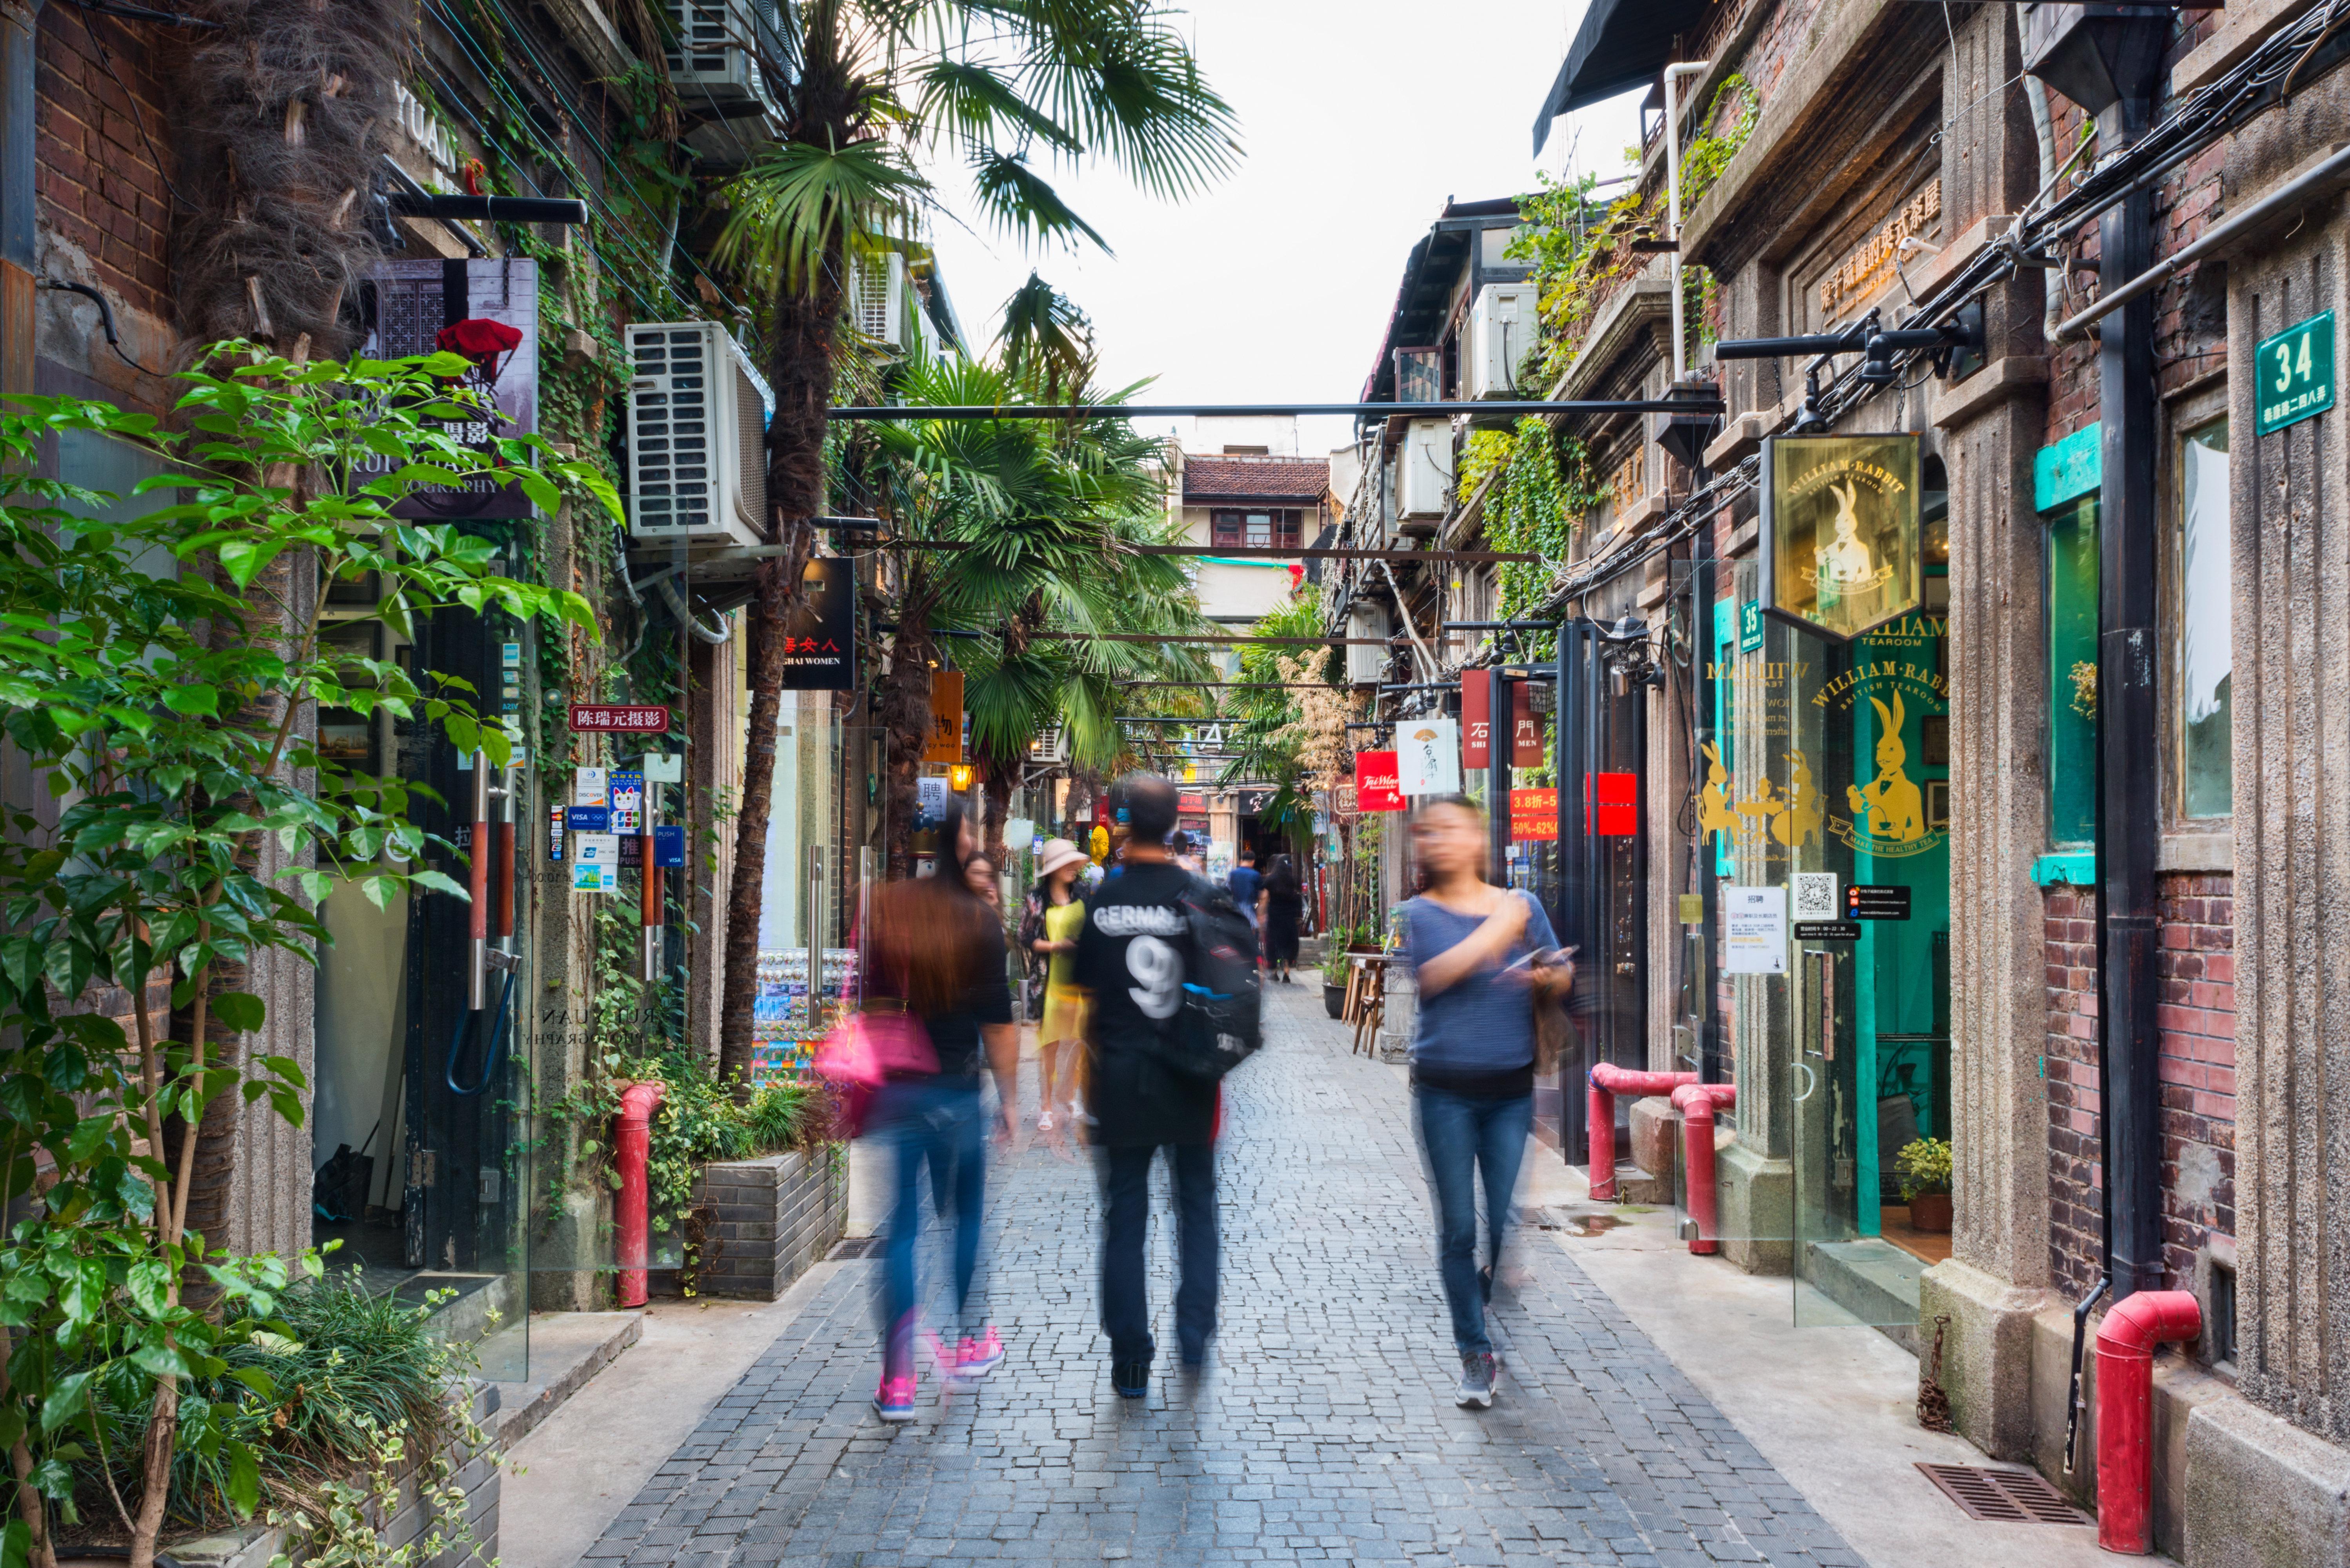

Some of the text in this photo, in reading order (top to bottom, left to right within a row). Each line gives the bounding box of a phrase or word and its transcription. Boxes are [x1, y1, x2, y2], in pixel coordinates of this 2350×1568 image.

[1836, 297, 1856, 318] William
[2276, 332, 2312, 393] 34
[1808, 473, 1884, 496] BRITISH TEAROOM
[1746, 606, 1757, 634] 35
[1862, 637, 1922, 646] TEAROOM
[1841, 681, 1941, 712] BRITISH TEAROOM
[578, 711, 660, 726] 陈瑞元摄影
[1471, 722, 1489, 738] 石
[1516, 720, 1534, 738] 門
[622, 838, 639, 855] 推
[1886, 843, 1918, 853] HEALTHY
[1919, 837, 1933, 847] TEA
[1125, 935, 1186, 1019] 9
